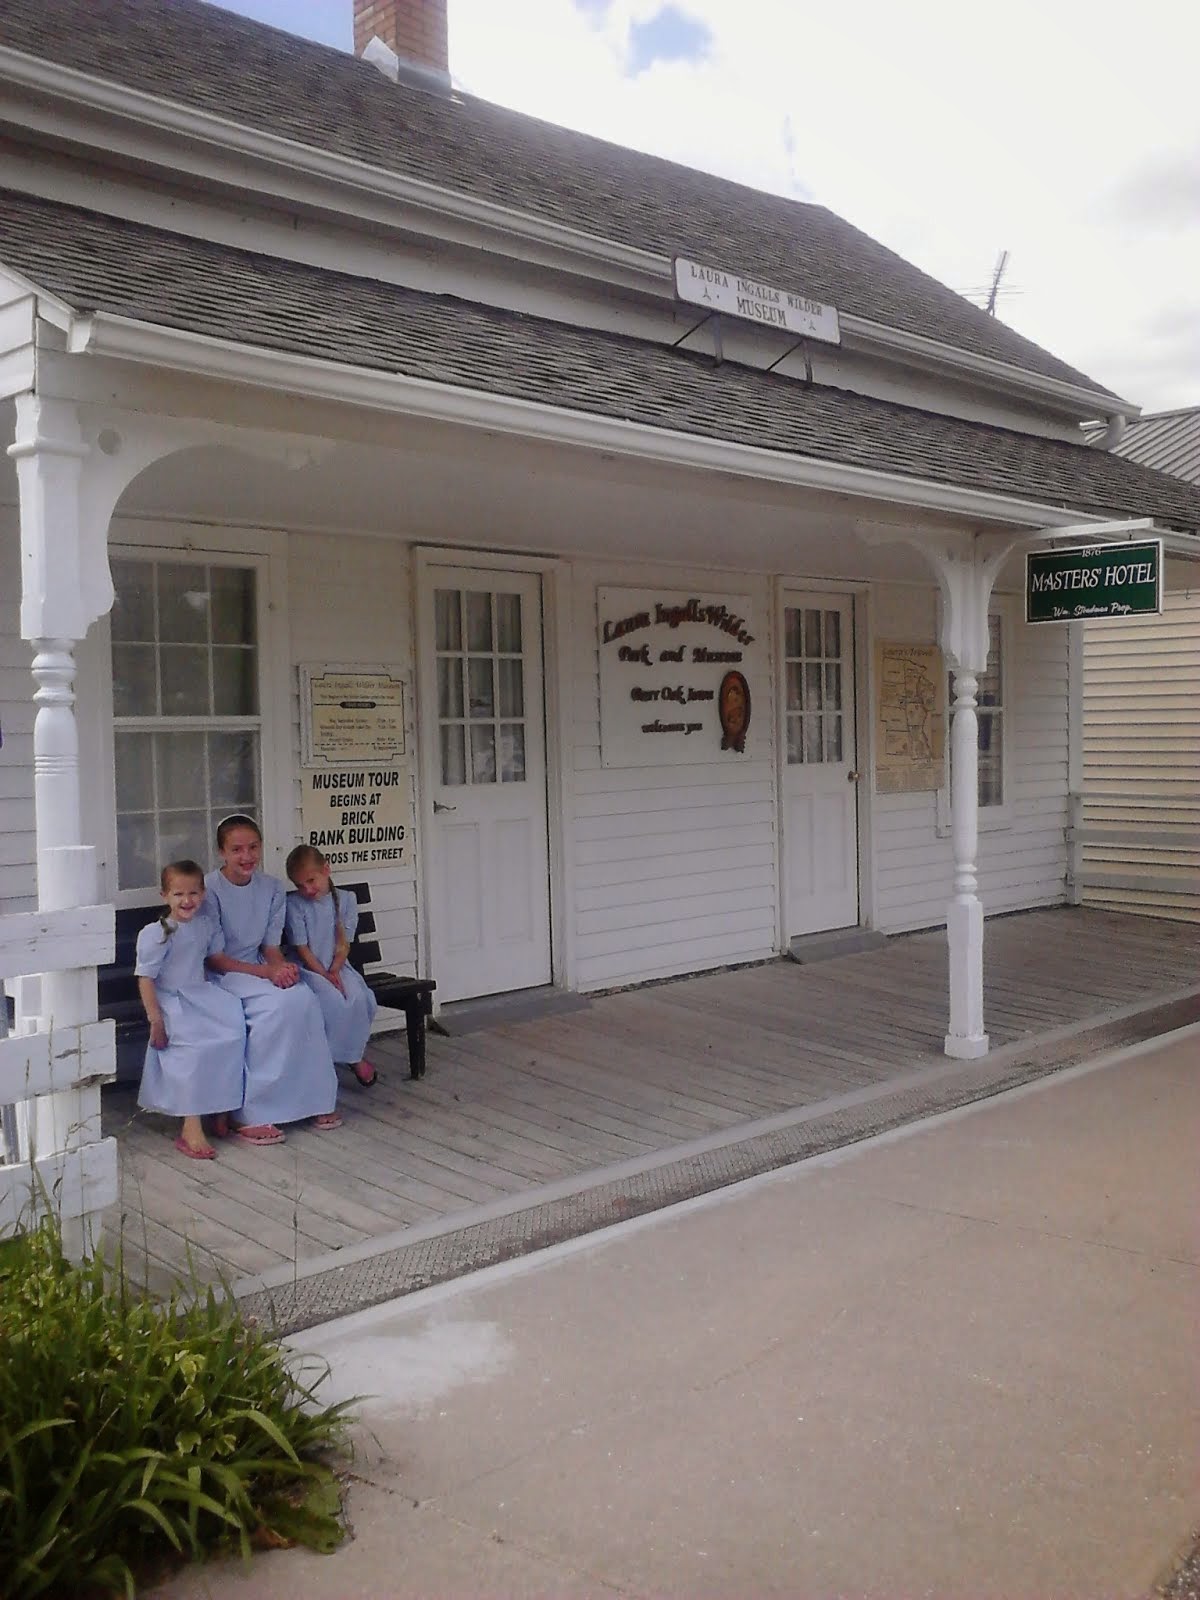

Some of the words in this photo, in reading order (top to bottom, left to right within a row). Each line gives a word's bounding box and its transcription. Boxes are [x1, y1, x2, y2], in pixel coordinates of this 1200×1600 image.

[691, 265, 729, 289] LAURA
[737, 280, 780, 303] INGALLS
[787, 295, 822, 317] WILDER
[736, 296, 787, 327] MUSEUM
[1031, 567, 1103, 593] MASTERS'
[1104, 562, 1156, 587] HOTEL
[603, 611, 651, 644] Laura
[654, 598, 706, 628] Ingalls
[705, 605, 756, 646] Wilder
[618, 643, 653, 666] Park
[659, 645, 687, 662] and
[692, 646, 743, 663] Museum
[312, 773, 365, 790] MUSEUM
[368, 771, 399, 787] TOUR
[330, 794, 367, 808] BEGINS
[369, 793, 382, 806] AT
[341, 811, 375, 826] BRICK
[309, 829, 345, 846] BANK
[348, 825, 405, 844] BUILDING
[352, 850, 369, 863] THE
[371, 848, 404, 861] STREET
